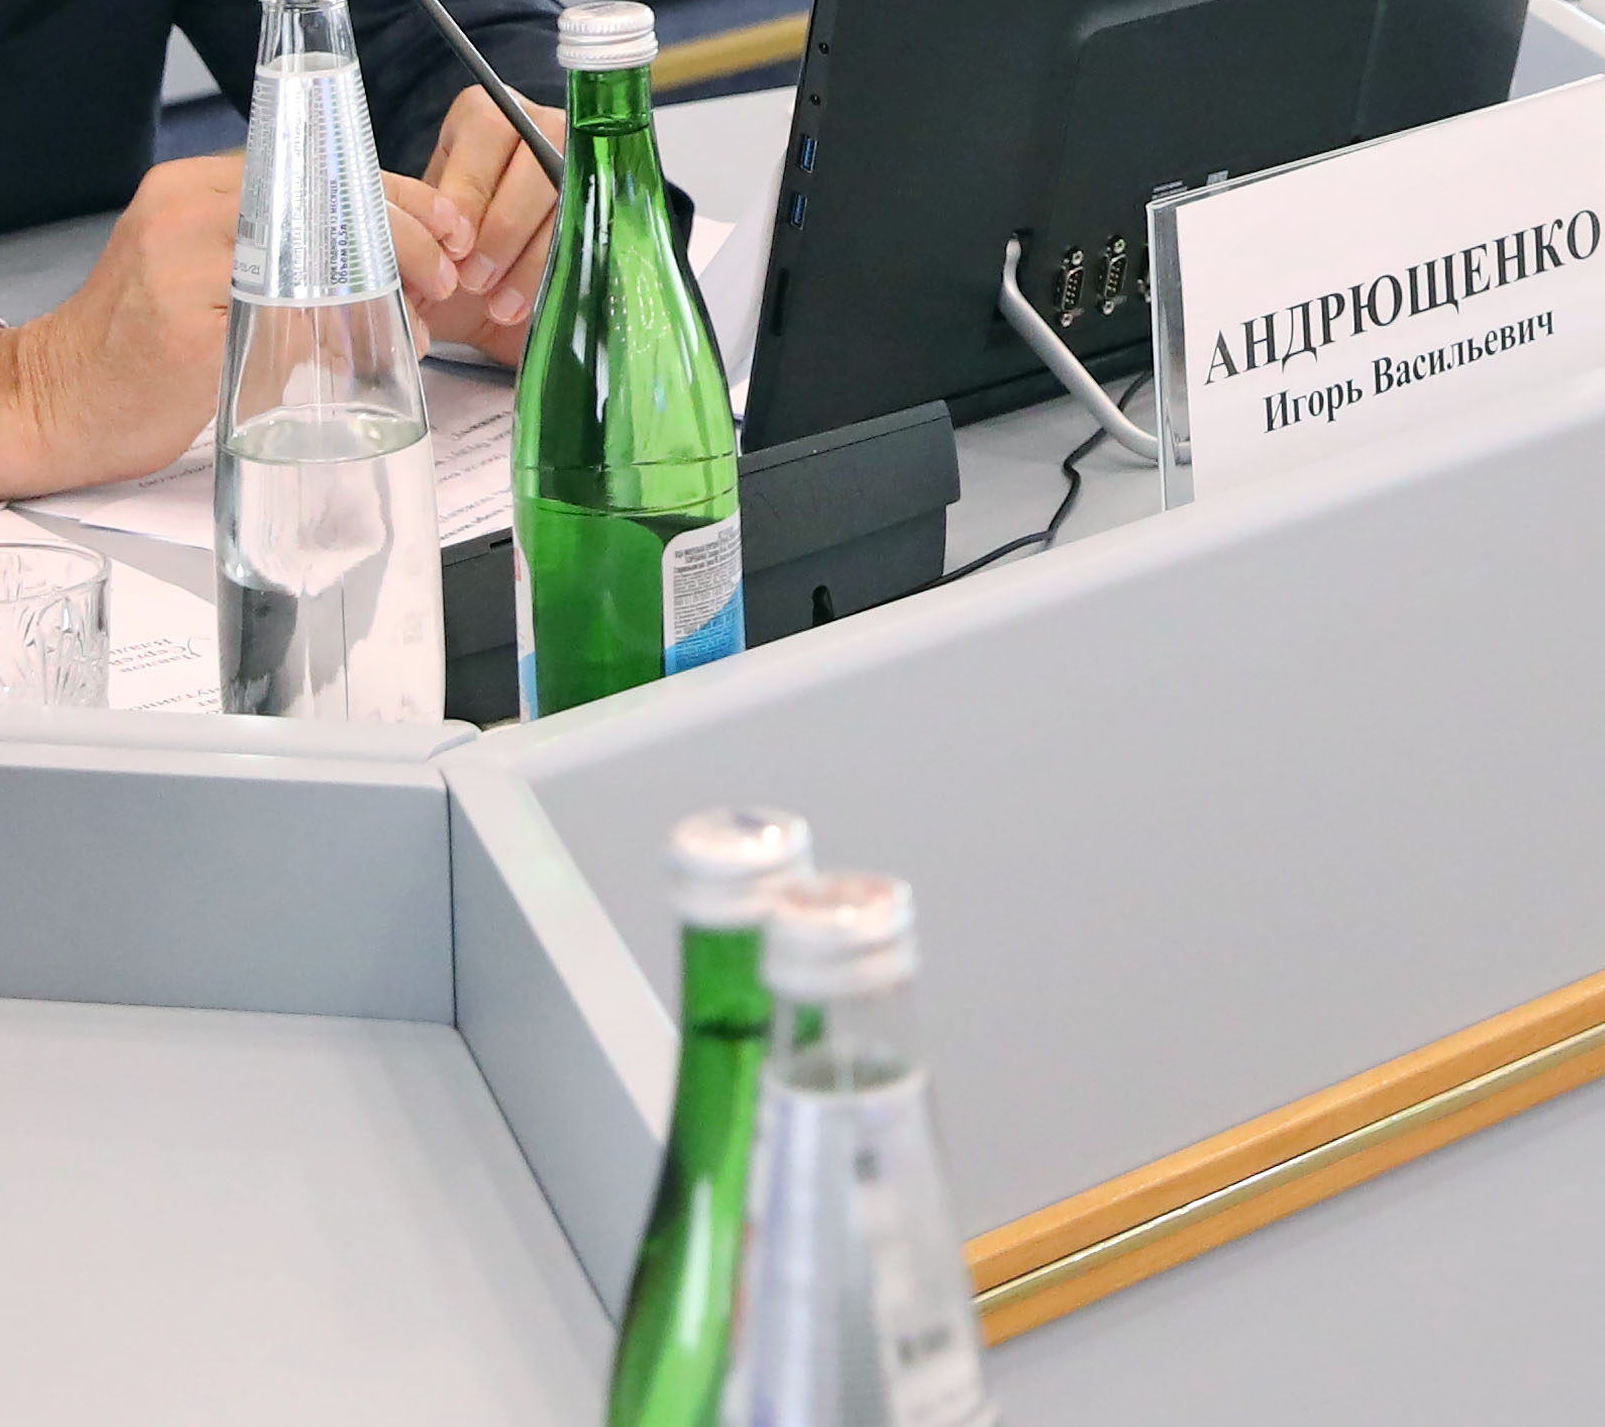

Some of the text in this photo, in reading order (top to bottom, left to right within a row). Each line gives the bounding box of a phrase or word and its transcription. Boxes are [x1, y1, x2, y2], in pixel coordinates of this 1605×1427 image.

[338, 248, 348, 284] Объем
[1203, 207, 1604, 386] АНДРЮЩЕНКО
[1262, 308, 1557, 435] Игорь Васильевич
